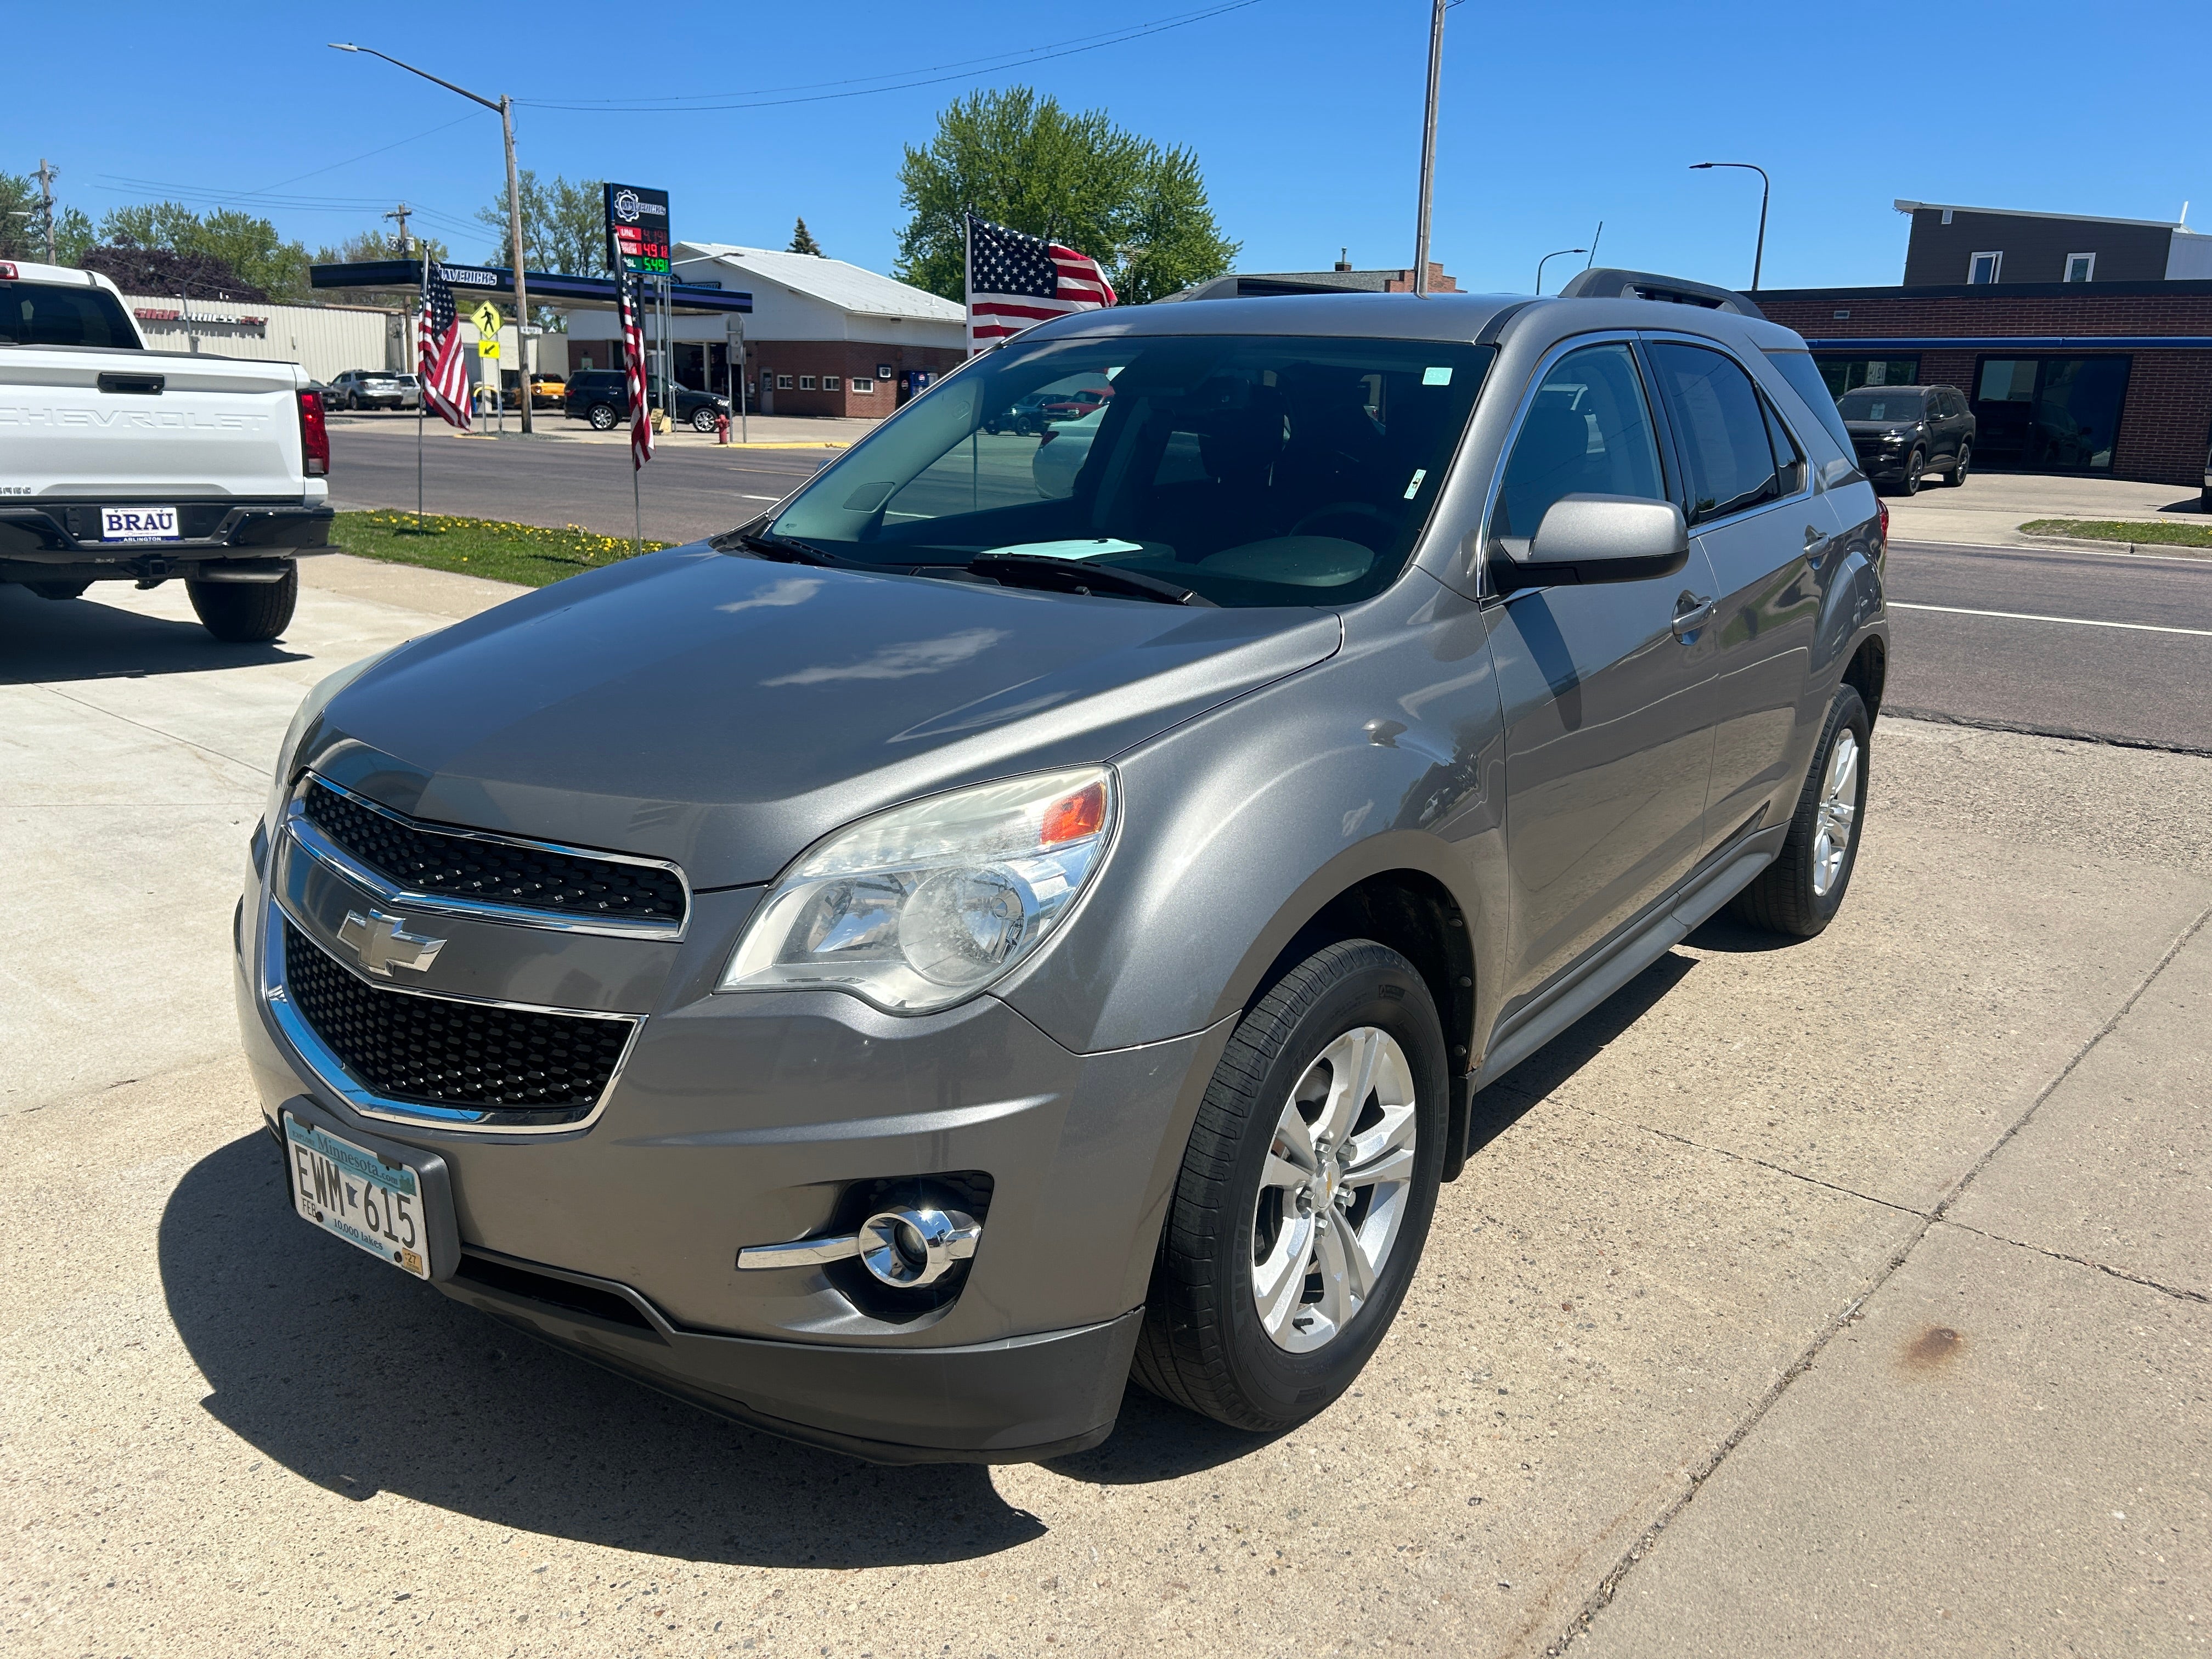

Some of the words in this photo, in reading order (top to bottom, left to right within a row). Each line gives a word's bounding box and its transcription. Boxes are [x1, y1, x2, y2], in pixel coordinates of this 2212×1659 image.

[106, 512, 173, 531] BRAU
[295, 1144, 345, 1217] EWM
[364, 1181, 416, 1249] 615
[302, 1199, 317, 1218] FEB
[334, 1218, 359, 1239] 10,000
[361, 1232, 383, 1250] lakes
[408, 1253, 416, 1265] 27
